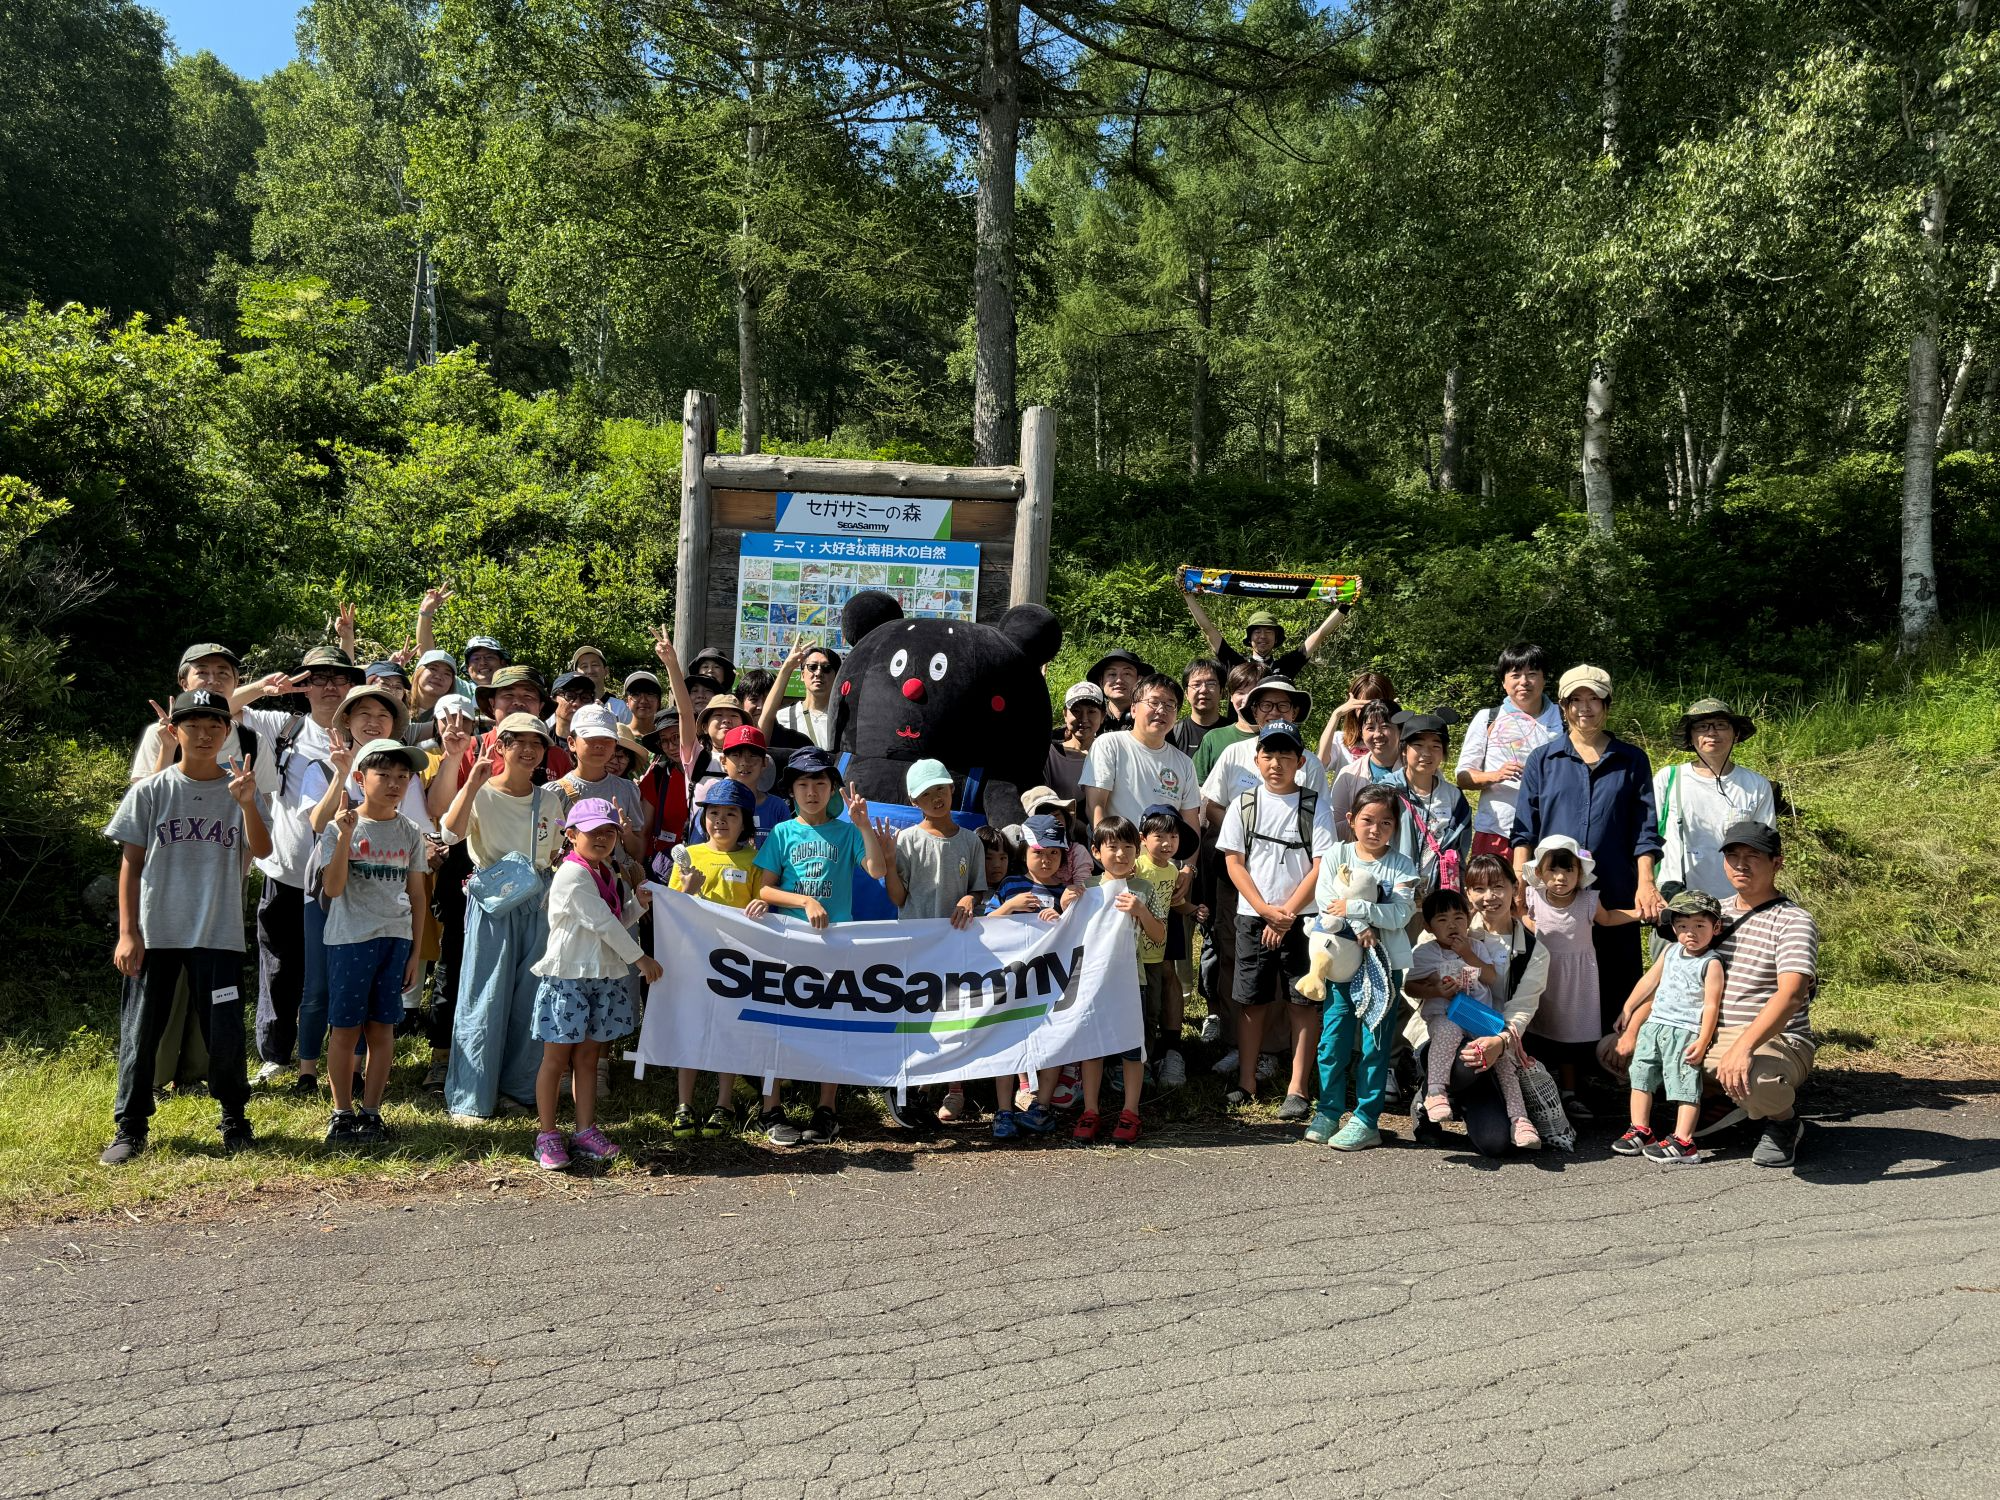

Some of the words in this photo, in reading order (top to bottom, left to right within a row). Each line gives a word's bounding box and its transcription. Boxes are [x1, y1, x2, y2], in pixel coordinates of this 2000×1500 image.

[806, 499, 922, 522] セガサミーの森
[837, 521, 890, 533] SEGASammy
[773, 540, 946, 559] テーマ：大好きな南相木の自然
[193, 690, 210, 704] NY
[1268, 722, 1294, 732] TOKYO
[156, 817, 239, 849] TEXAS
[791, 841, 839, 865] SAUSALITO
[805, 861, 823, 878] LOS
[793, 880, 833, 898] ANGELES
[706, 945, 1084, 1014] SEGASammy
